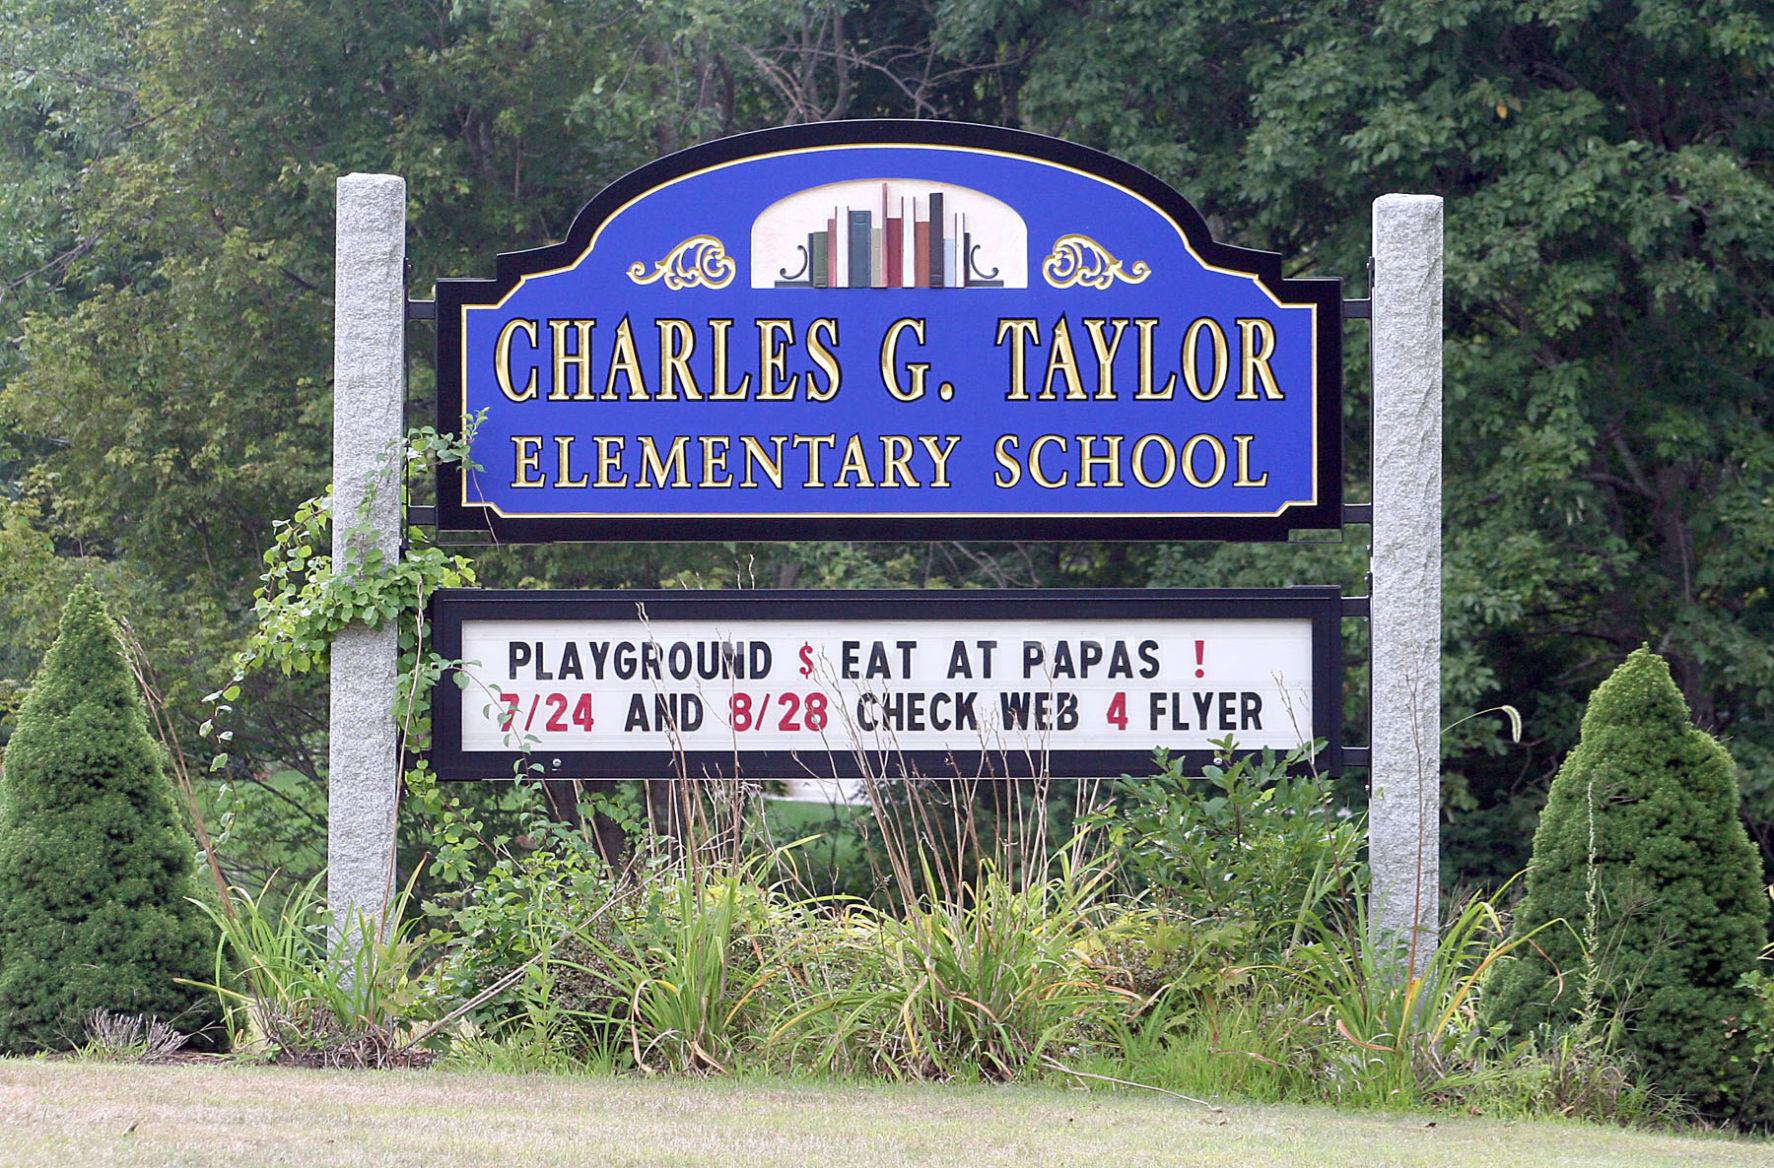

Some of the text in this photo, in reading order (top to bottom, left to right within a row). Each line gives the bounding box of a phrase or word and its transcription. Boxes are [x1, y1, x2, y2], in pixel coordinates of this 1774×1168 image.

[494, 312, 1286, 402] CHARLES G. TAYLOR
[510, 432, 1269, 490] ELEMENTARY SCHOOL
[508, 641, 773, 681] PLAYGROUND
[799, 640, 815, 681] $
[841, 640, 917, 680] EAT
[947, 640, 998, 680] AT
[1023, 640, 1160, 680] PAPAS
[499, 691, 1263, 733] 7/24 AND 8/28 CHECK WEB 4 FLYER
